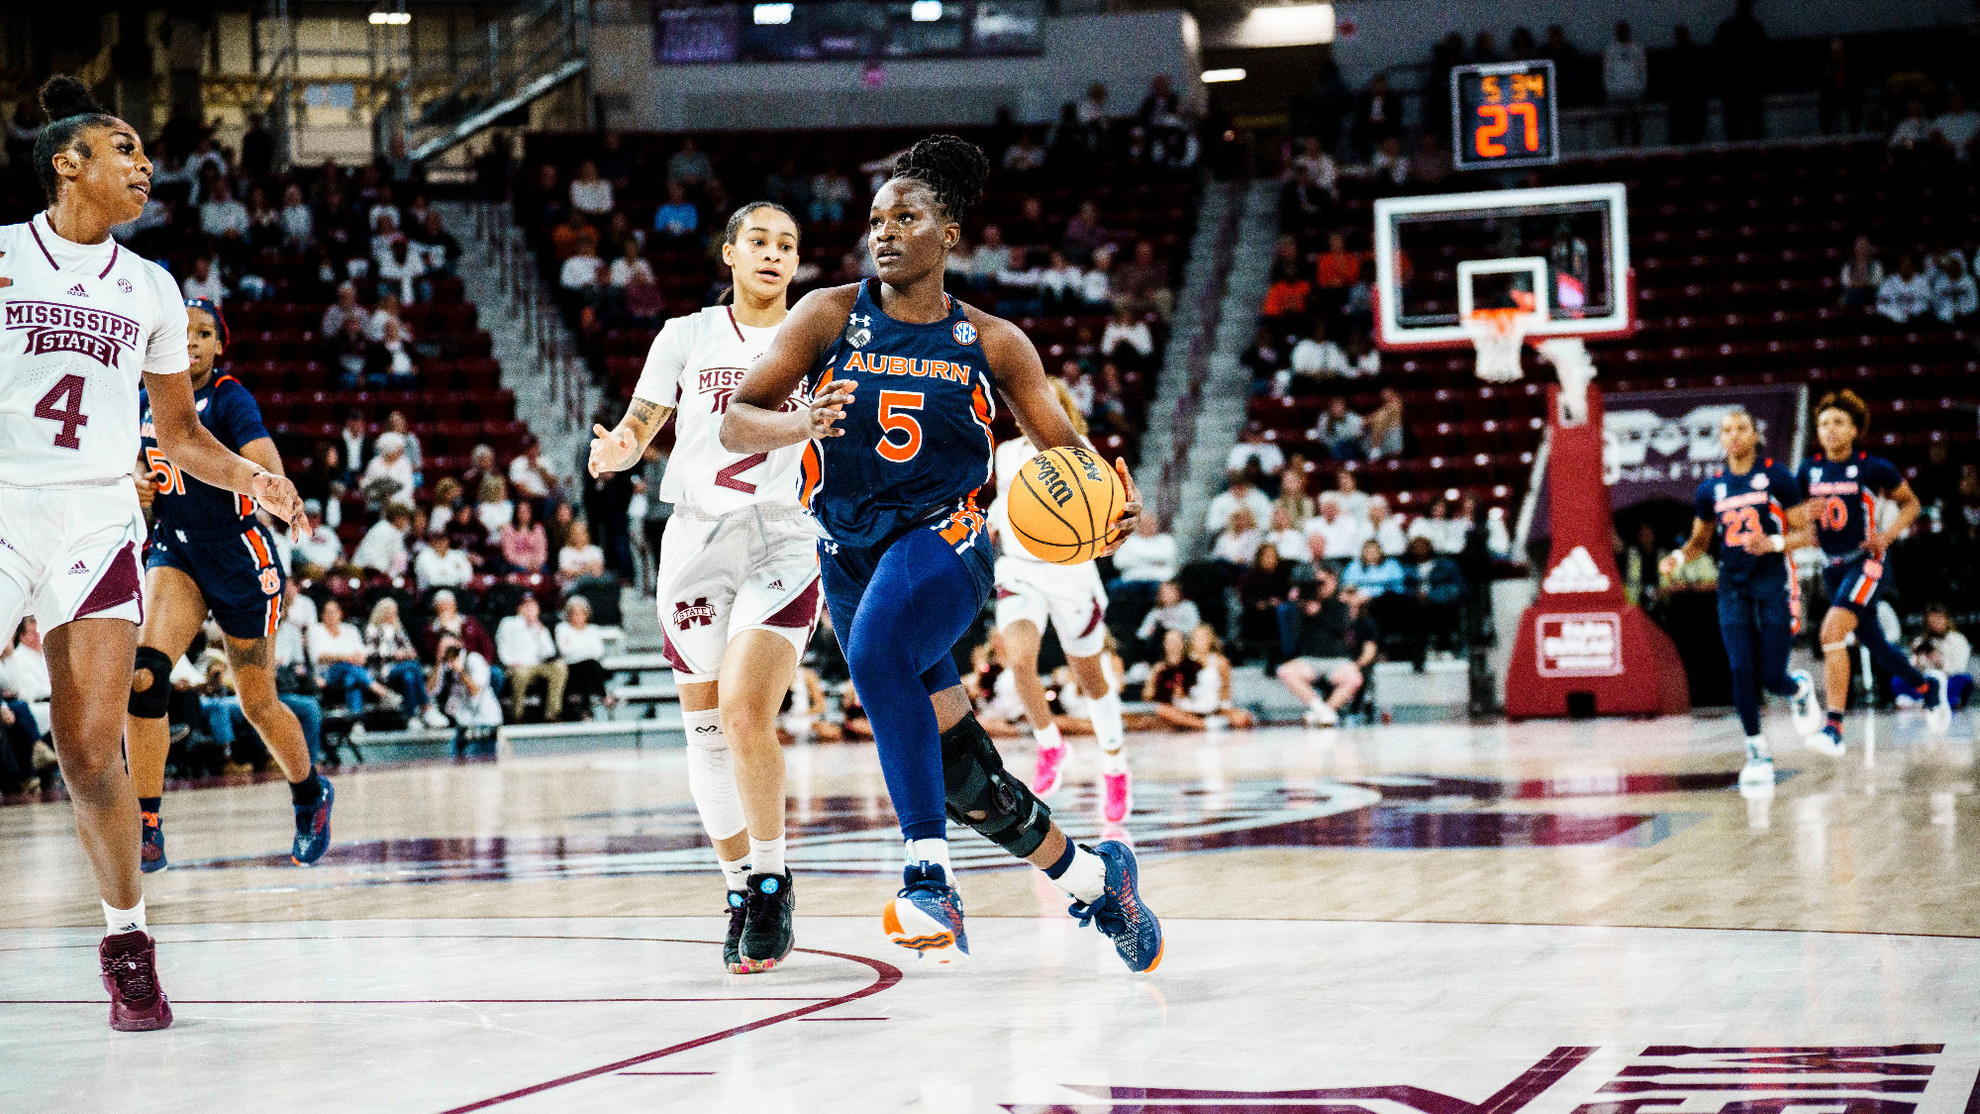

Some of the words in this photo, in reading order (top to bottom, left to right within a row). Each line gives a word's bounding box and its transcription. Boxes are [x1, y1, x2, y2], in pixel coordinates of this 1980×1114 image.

[1475, 102, 1538, 157] 27
[5, 304, 140, 346] MISSISSIPPI
[954, 322, 978, 344] SEC
[41, 333, 107, 361] STATE
[843, 351, 971, 385] AUBURN
[34, 373, 88, 450] 4
[875, 389, 925, 463] 5
[145, 446, 186, 495] 51
[1721, 506, 1763, 547] 23
[680, 607, 708, 620] STATE
